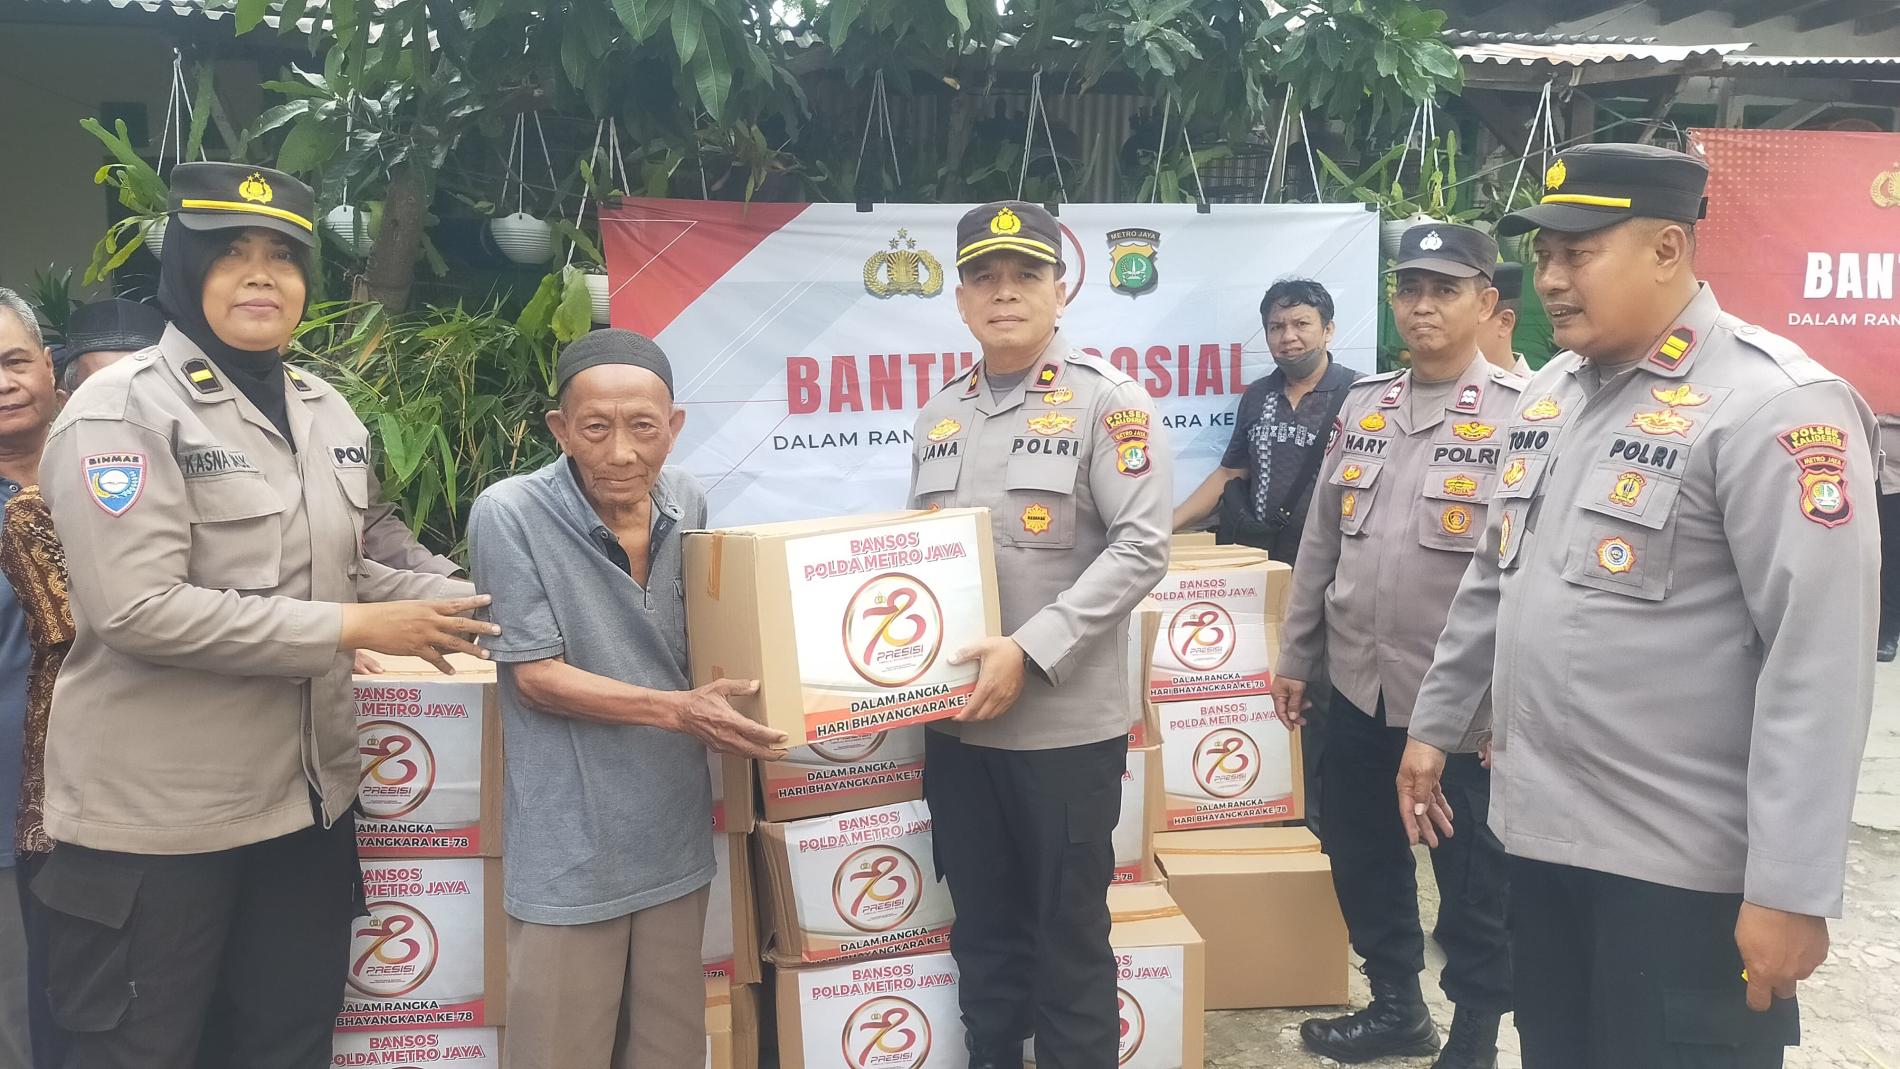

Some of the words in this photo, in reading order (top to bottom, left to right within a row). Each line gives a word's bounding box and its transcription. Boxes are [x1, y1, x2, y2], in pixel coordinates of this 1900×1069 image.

[1110, 231, 1137, 240] METRO
[1138, 231, 1156, 240] JAYA
[1788, 312, 1857, 326] DALAM
[1105, 410, 1149, 425] POLSEK
[773, 432, 858, 451] DALAM
[1790, 426, 1840, 441] POLSEK
[922, 441, 958, 462] JANA
[1011, 438, 1079, 457] POLRI
[1345, 434, 1388, 455] HARY
[88, 455, 140, 466] BINMAS
[1433, 447, 1500, 465] POLRI
[1609, 438, 1678, 470] POLRI
[850, 532, 920, 555] BANSOS
[804, 558, 864, 581] POLDA
[864, 549, 924, 573] METRO
[924, 542, 967, 563] JAYA
[1179, 578, 1227, 590] BANSOS
[1187, 588, 1227, 600] METRO
[1228, 586, 1257, 597] JAYA
[876, 643, 925, 662] PRESISI
[1173, 675, 1203, 685] DALAM
[1204, 673, 1241, 682] RANGKA
[1150, 687, 1172, 696] HARI
[1173, 681, 1239, 694] BHAYANGKARA
[850, 694, 896, 713] DALAM
[898, 683, 950, 703] RANGKA
[361, 702, 423, 718] METRO
[424, 704, 469, 719] JAYA
[1200, 703, 1247, 716] BANSOS
[817, 721, 850, 737] HARI
[851, 700, 947, 730] BHAYANGKARA
[1169, 718, 1208, 730] POLDA
[1209, 713, 1248, 726] METRO
[1249, 710, 1278, 722] JAYA
[806, 767, 848, 782] DALAM
[848, 761, 897, 776] RANGKA
[363, 786, 412, 795] PRESISI
[778, 785, 807, 798] HARI
[808, 773, 895, 794] BHAYANGKARA
[1196, 803, 1227, 813] DALAM
[1227, 799, 1264, 808] RANGKA
[839, 811, 900, 831] BANSOS
[1174, 815, 1195, 825] HARI
[1196, 807, 1261, 822] BHAYANGKARA
[380, 824, 435, 834] RANGKA
[799, 835, 849, 853] POLDA
[850, 825, 904, 846] METRO
[904, 819, 933, 836] JAY
[432, 838, 469, 848] KE-78
[363, 883, 424, 898] METRO
[425, 880, 470, 896] JAYA
[862, 898, 905, 914] PRESISI
[840, 936, 881, 952] DALAM
[881, 927, 929, 944] RANGKA
[366, 965, 416, 974] PRESISI
[852, 964, 914, 982] BANSOS
[1134, 966, 1170, 979] JAYA
[812, 984, 863, 1001] POLDA
[864, 977, 917, 995] METRO
[917, 973, 956, 989] JAYA
[384, 1000, 439, 1012] RANGKA
[336, 1013, 432, 1027] BHAYANGKARA
[435, 1011, 473, 1023] KE-78
[369, 1033, 438, 1050] BANSOS
[331, 1052, 380, 1067] OLDA
[382, 1048, 441, 1065] METRO
[441, 1045, 486, 1061] JAYA
[870, 1052, 913, 1064] PRESISI
